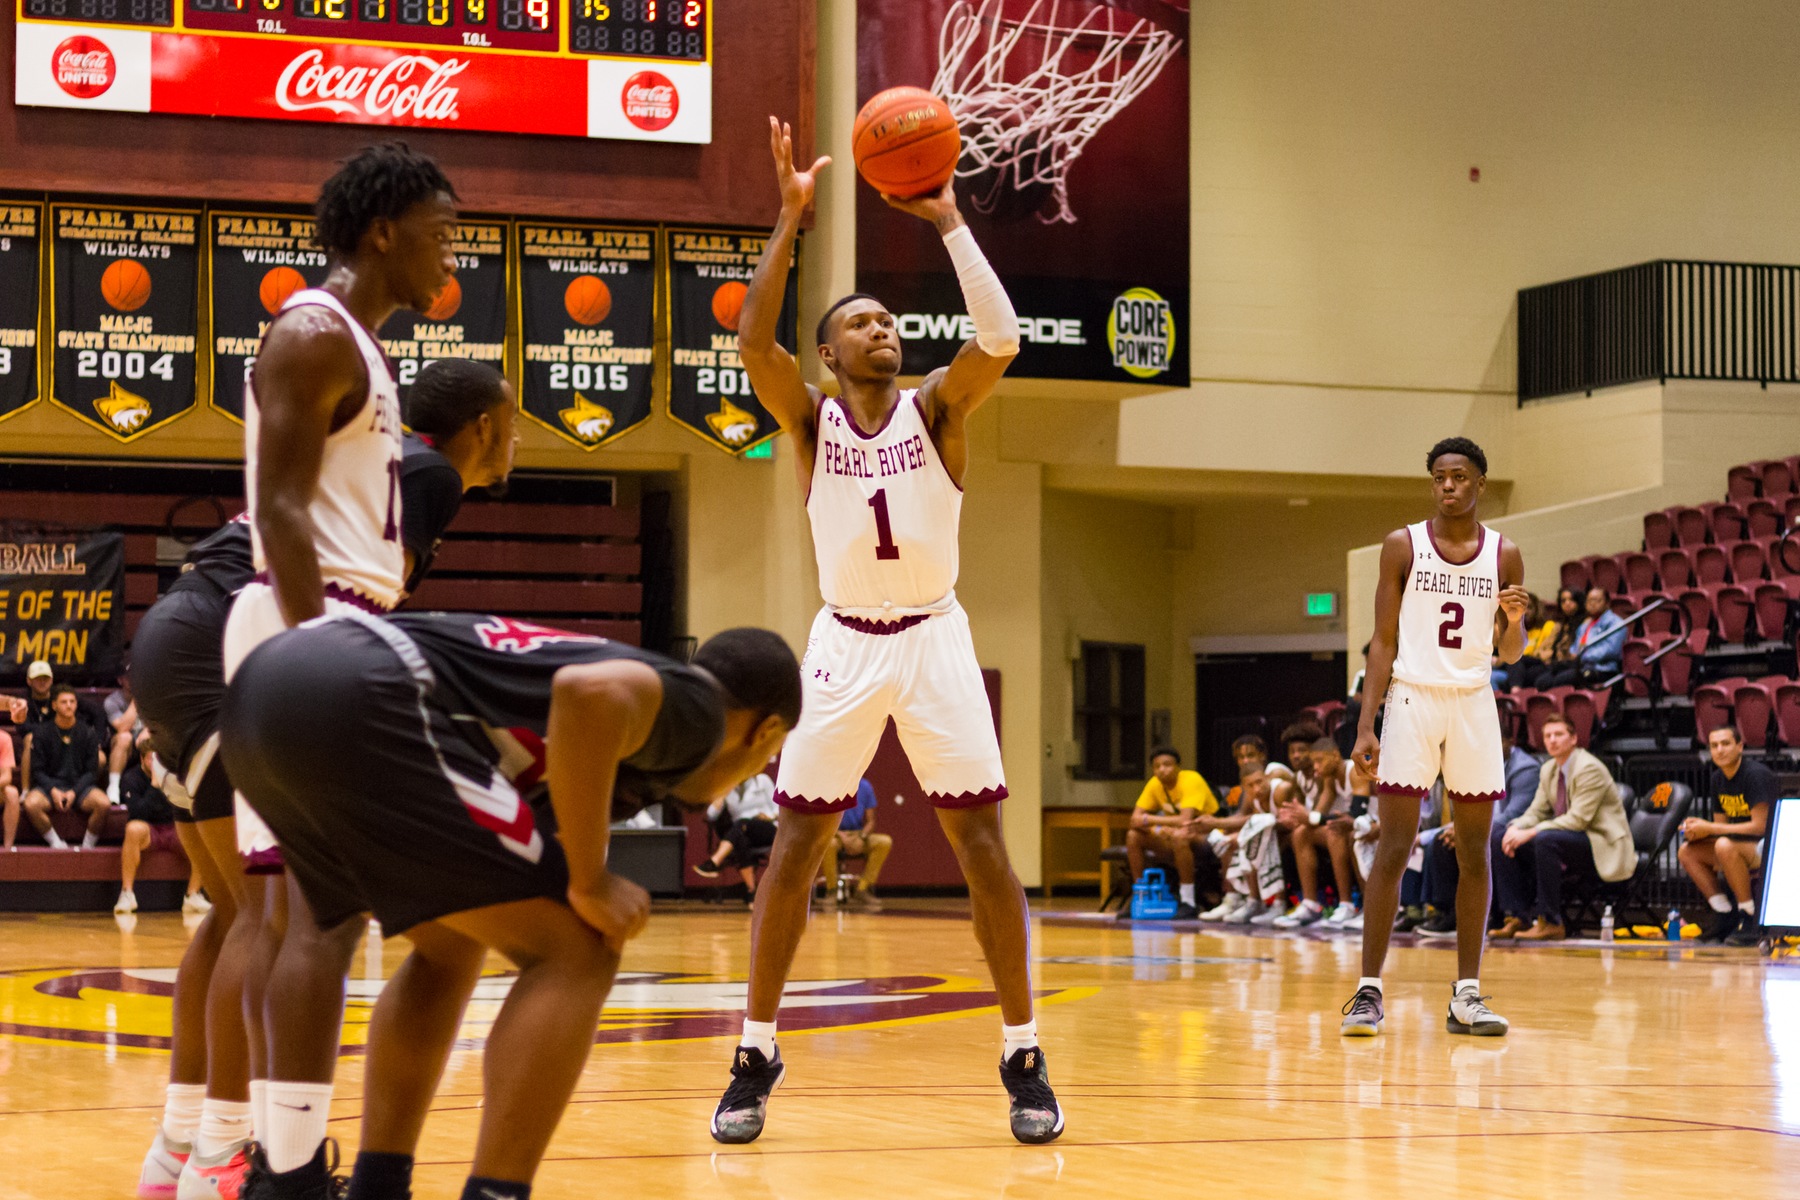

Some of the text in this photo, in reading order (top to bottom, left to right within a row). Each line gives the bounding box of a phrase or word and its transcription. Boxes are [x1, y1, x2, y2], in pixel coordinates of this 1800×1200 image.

[526, 0, 549, 30] 9
[684, 0, 701, 27] 2
[58, 71, 108, 86] UNITED
[275, 49, 471, 121] Coca-Cola
[626, 105, 673, 119] UNITED
[59, 209, 195, 232] PEARL RIVER
[218, 217, 283, 236] PEARL
[84, 241, 171, 259] WILDCATS
[524, 228, 650, 249] PEARL RIVER
[674, 234, 734, 252] PEARL
[242, 249, 327, 267] WILDCATS
[548, 258, 629, 275] WILDCATS
[696, 264, 755, 280] WILDCA
[100, 314, 153, 334] MACJC
[893, 313, 1082, 345] OWEADE
[1115, 298, 1169, 339] CORE
[58, 330, 104, 350] STATE
[109, 333, 195, 354] CHAMPIONS
[413, 323, 465, 342] MACJC
[563, 328, 614, 347] MACJC
[381, 339, 504, 361] TATE CHAMPIONS
[525, 344, 652, 365] STATE CHAMPIONS
[674, 348, 717, 368] STATE
[1114, 338, 1168, 369] POWER
[78, 350, 174, 381] 2004
[549, 363, 629, 391] 2015
[696, 368, 752, 396] 201
[824, 434, 926, 478] PEARL RIVER
[868, 488, 900, 560] 1
[1415, 571, 1493, 599] PEARL RIVER
[17, 590, 54, 620] OF
[62, 590, 113, 620] THE
[1438, 601, 1465, 650] 2
[16, 629, 89, 665] MAN
